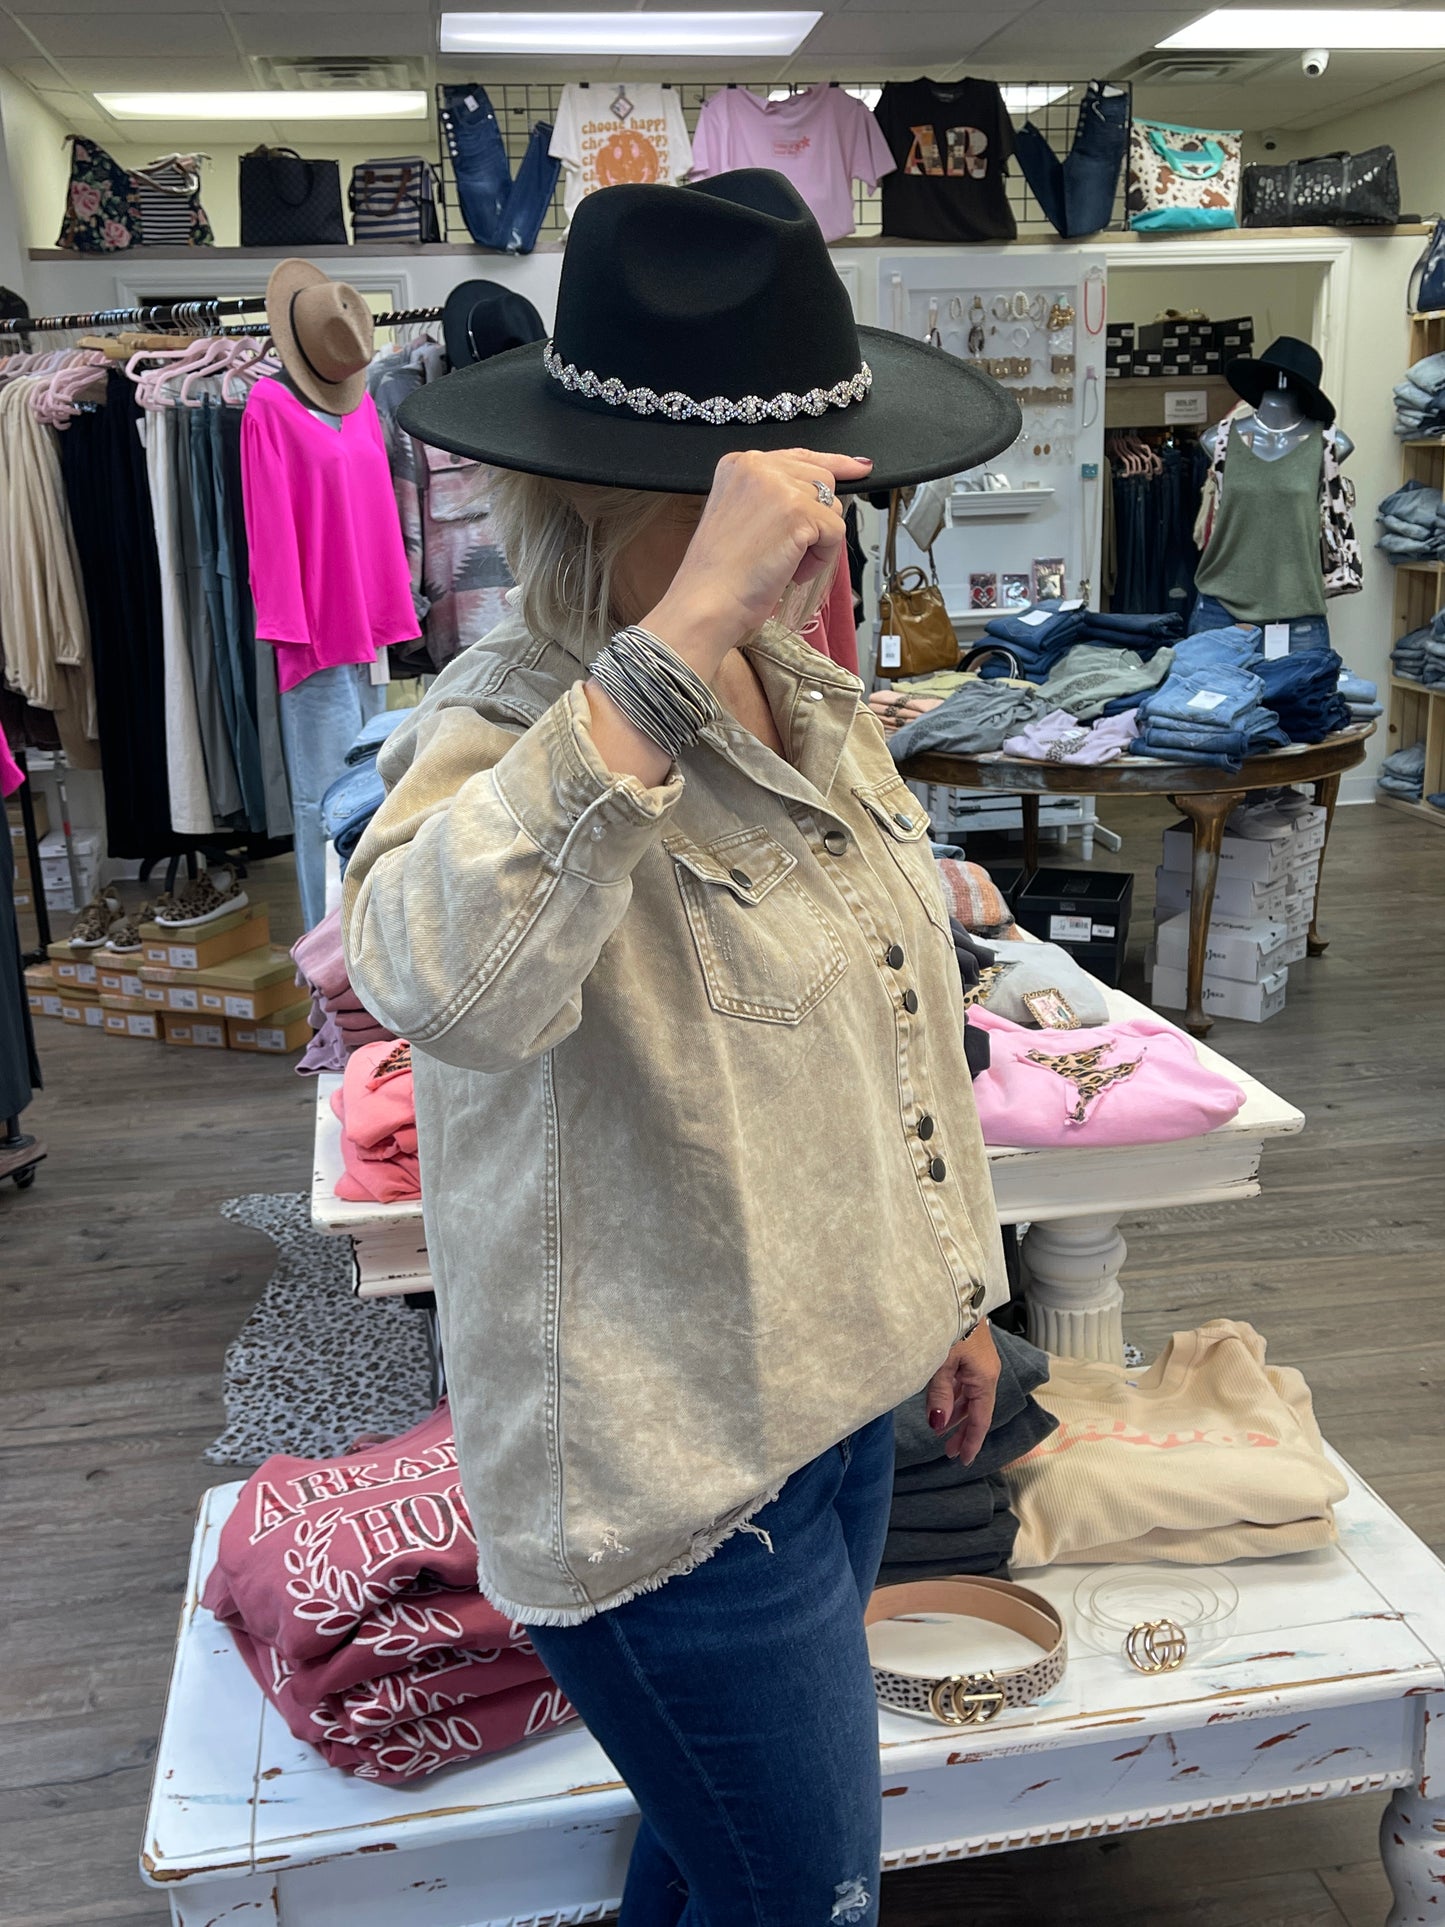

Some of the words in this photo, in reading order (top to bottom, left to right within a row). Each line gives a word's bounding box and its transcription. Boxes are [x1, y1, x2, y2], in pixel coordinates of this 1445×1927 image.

[581, 120, 625, 134] choose
[630, 117, 666, 132] happy
[904, 124, 989, 180] AR
